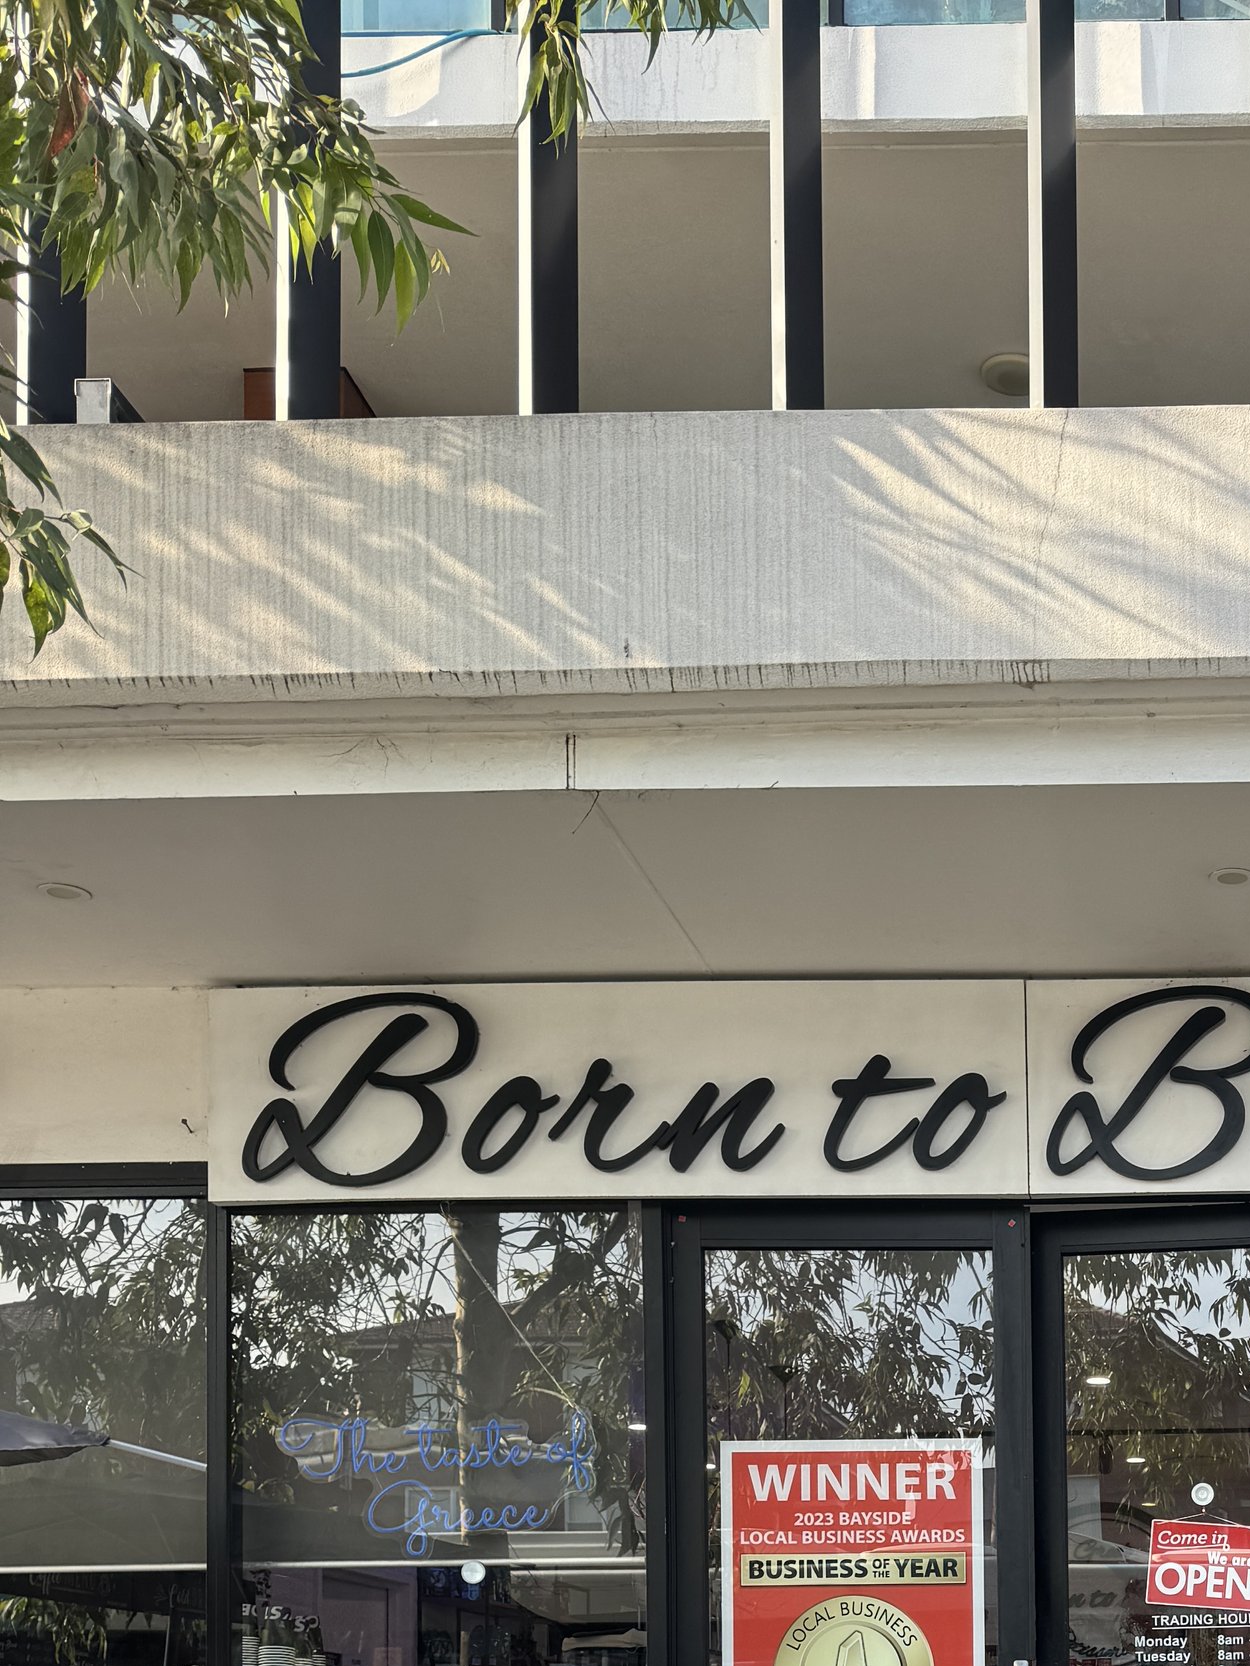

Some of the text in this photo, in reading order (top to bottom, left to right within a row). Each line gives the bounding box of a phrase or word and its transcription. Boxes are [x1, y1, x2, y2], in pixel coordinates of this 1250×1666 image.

[242, 992, 785, 1188] Born
[823, 1054, 1007, 1172] to
[280, 1410, 595, 1492] The taste of
[747, 1463, 957, 1502] WINNER
[367, 1480, 550, 1557] Greece
[794, 1511, 911, 1527] 2023 BAYSIDE
[740, 1529, 965, 1545] LOCAL BUSINESS AWARDS
[1158, 1531, 1230, 1550] Come in
[1207, 1551, 1228, 1566] We
[748, 1557, 958, 1580] BUSINESS OF YEAR
[872, 1570, 890, 1579] THE
[785, 1602, 918, 1651] LOCAL BUSINESS
[1152, 1614, 1214, 1626] TRADING
[1135, 1635, 1187, 1648] Monday
[1217, 1635, 1244, 1645] 8am
[1136, 1651, 1191, 1664] Tuesday
[1218, 1649, 1244, 1660] 8am
